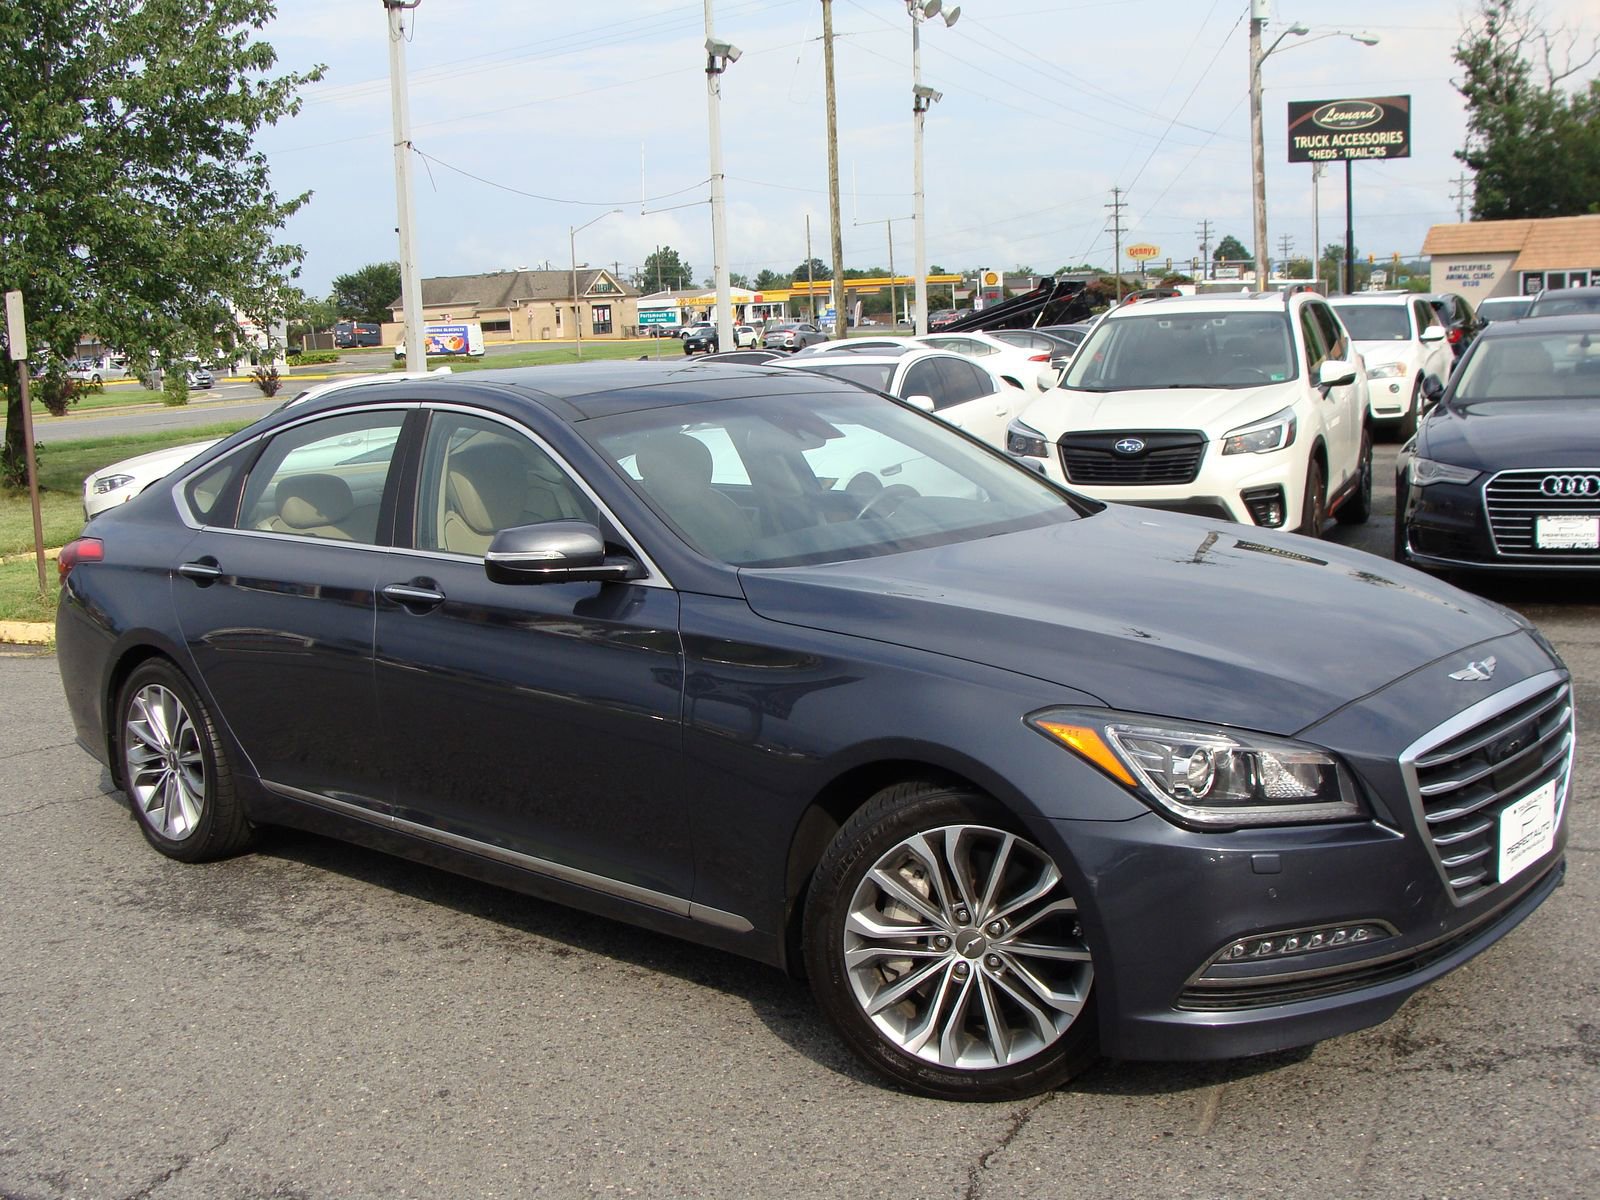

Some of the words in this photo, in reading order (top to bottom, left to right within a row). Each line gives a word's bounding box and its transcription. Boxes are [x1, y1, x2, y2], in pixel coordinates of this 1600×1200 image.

[1320, 107, 1376, 122] Leonard
[1294, 135, 1329, 148] TRUCK
[1331, 131, 1403, 146] ACCESSORIES
[1449, 264, 1492, 272] BATTLEFIELD
